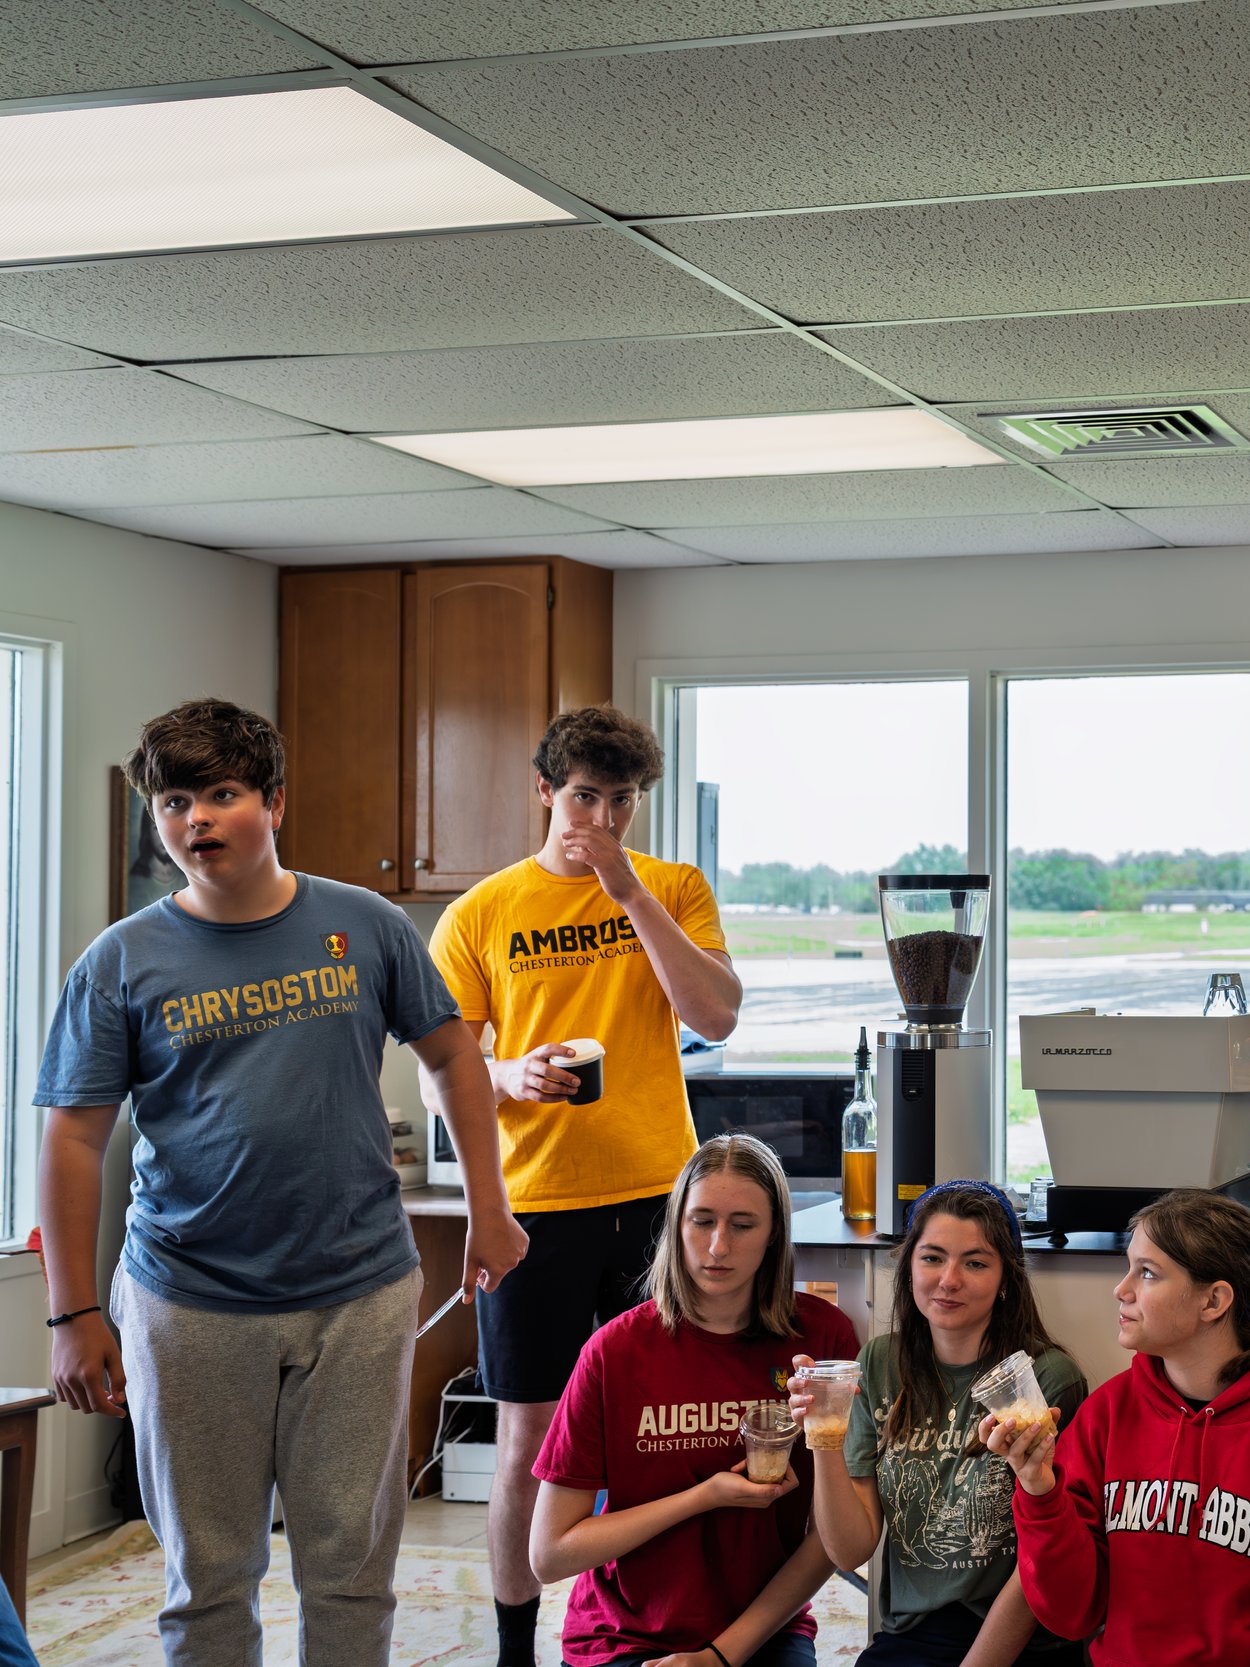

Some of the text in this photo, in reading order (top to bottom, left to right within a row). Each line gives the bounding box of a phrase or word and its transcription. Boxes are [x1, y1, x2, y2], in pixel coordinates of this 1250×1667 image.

[509, 915, 638, 960] AMBROS
[596, 943, 645, 961] ACADE
[162, 965, 359, 1033] CHRYSOSTOM
[1104, 1479, 1199, 1535] LMONT
[952, 1545, 1016, 1569] AUSTI TX
